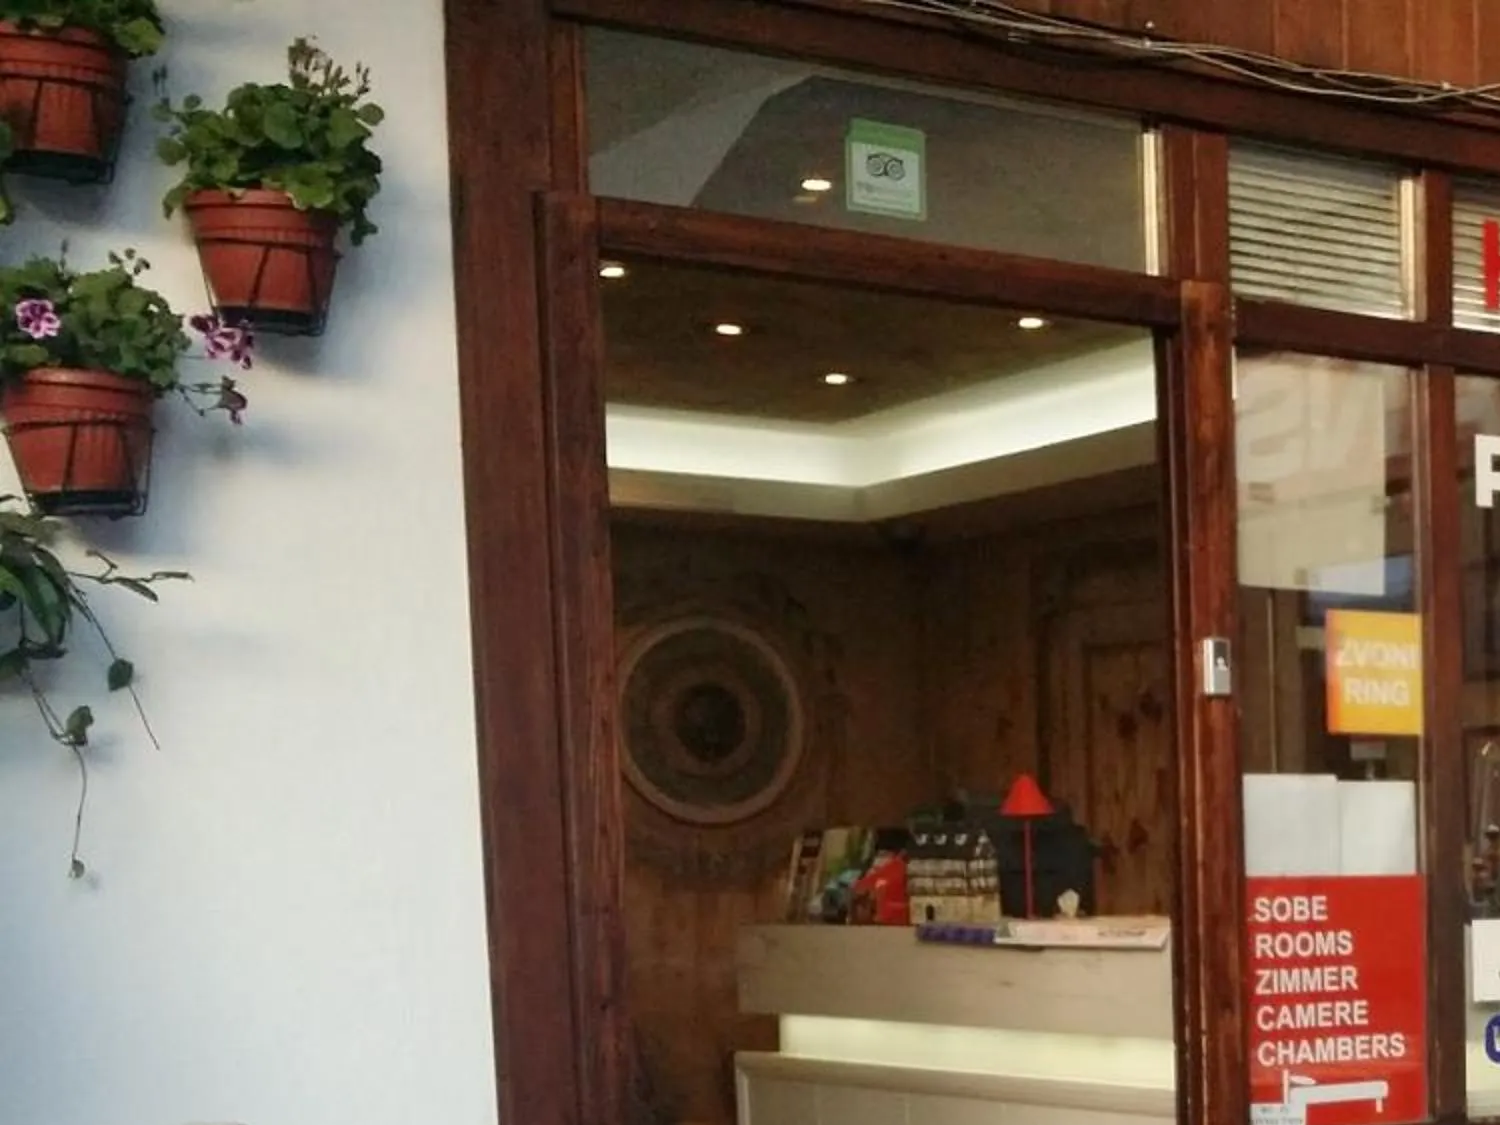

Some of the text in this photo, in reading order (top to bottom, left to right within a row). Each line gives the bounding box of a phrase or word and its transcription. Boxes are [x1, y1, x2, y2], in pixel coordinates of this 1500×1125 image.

[1343, 677, 1410, 706] RING
[1255, 895, 1329, 923] SOBE
[1255, 930, 1354, 959] ROOMS
[1255, 965, 1360, 996] ZIMMER
[1256, 1000, 1370, 1031] CAMERE
[1257, 1032, 1406, 1067] CHAMBERS
